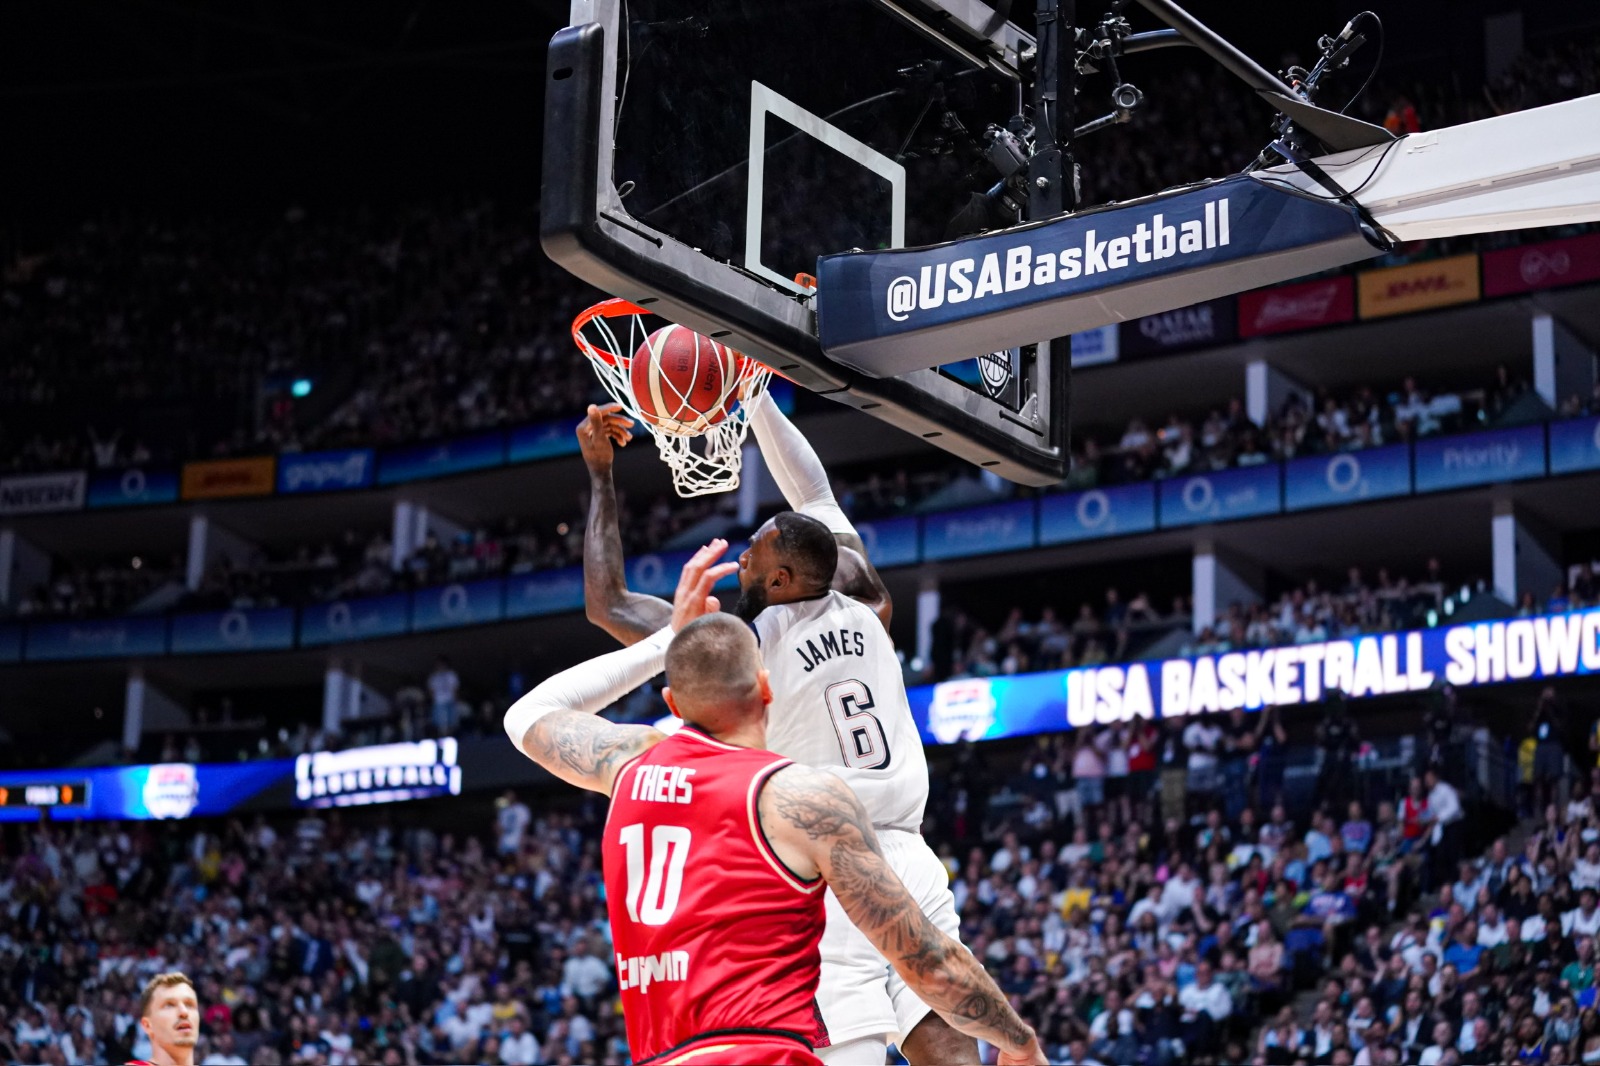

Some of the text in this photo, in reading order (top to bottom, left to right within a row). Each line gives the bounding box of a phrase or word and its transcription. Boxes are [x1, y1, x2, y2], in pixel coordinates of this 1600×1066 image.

[886, 198, 1231, 322] @USABasketball
[796, 629, 864, 672] JAMES
[825, 678, 891, 770] 6
[1066, 663, 1156, 727] USA
[631, 764, 697, 805] THEIS
[619, 822, 692, 926] 10
